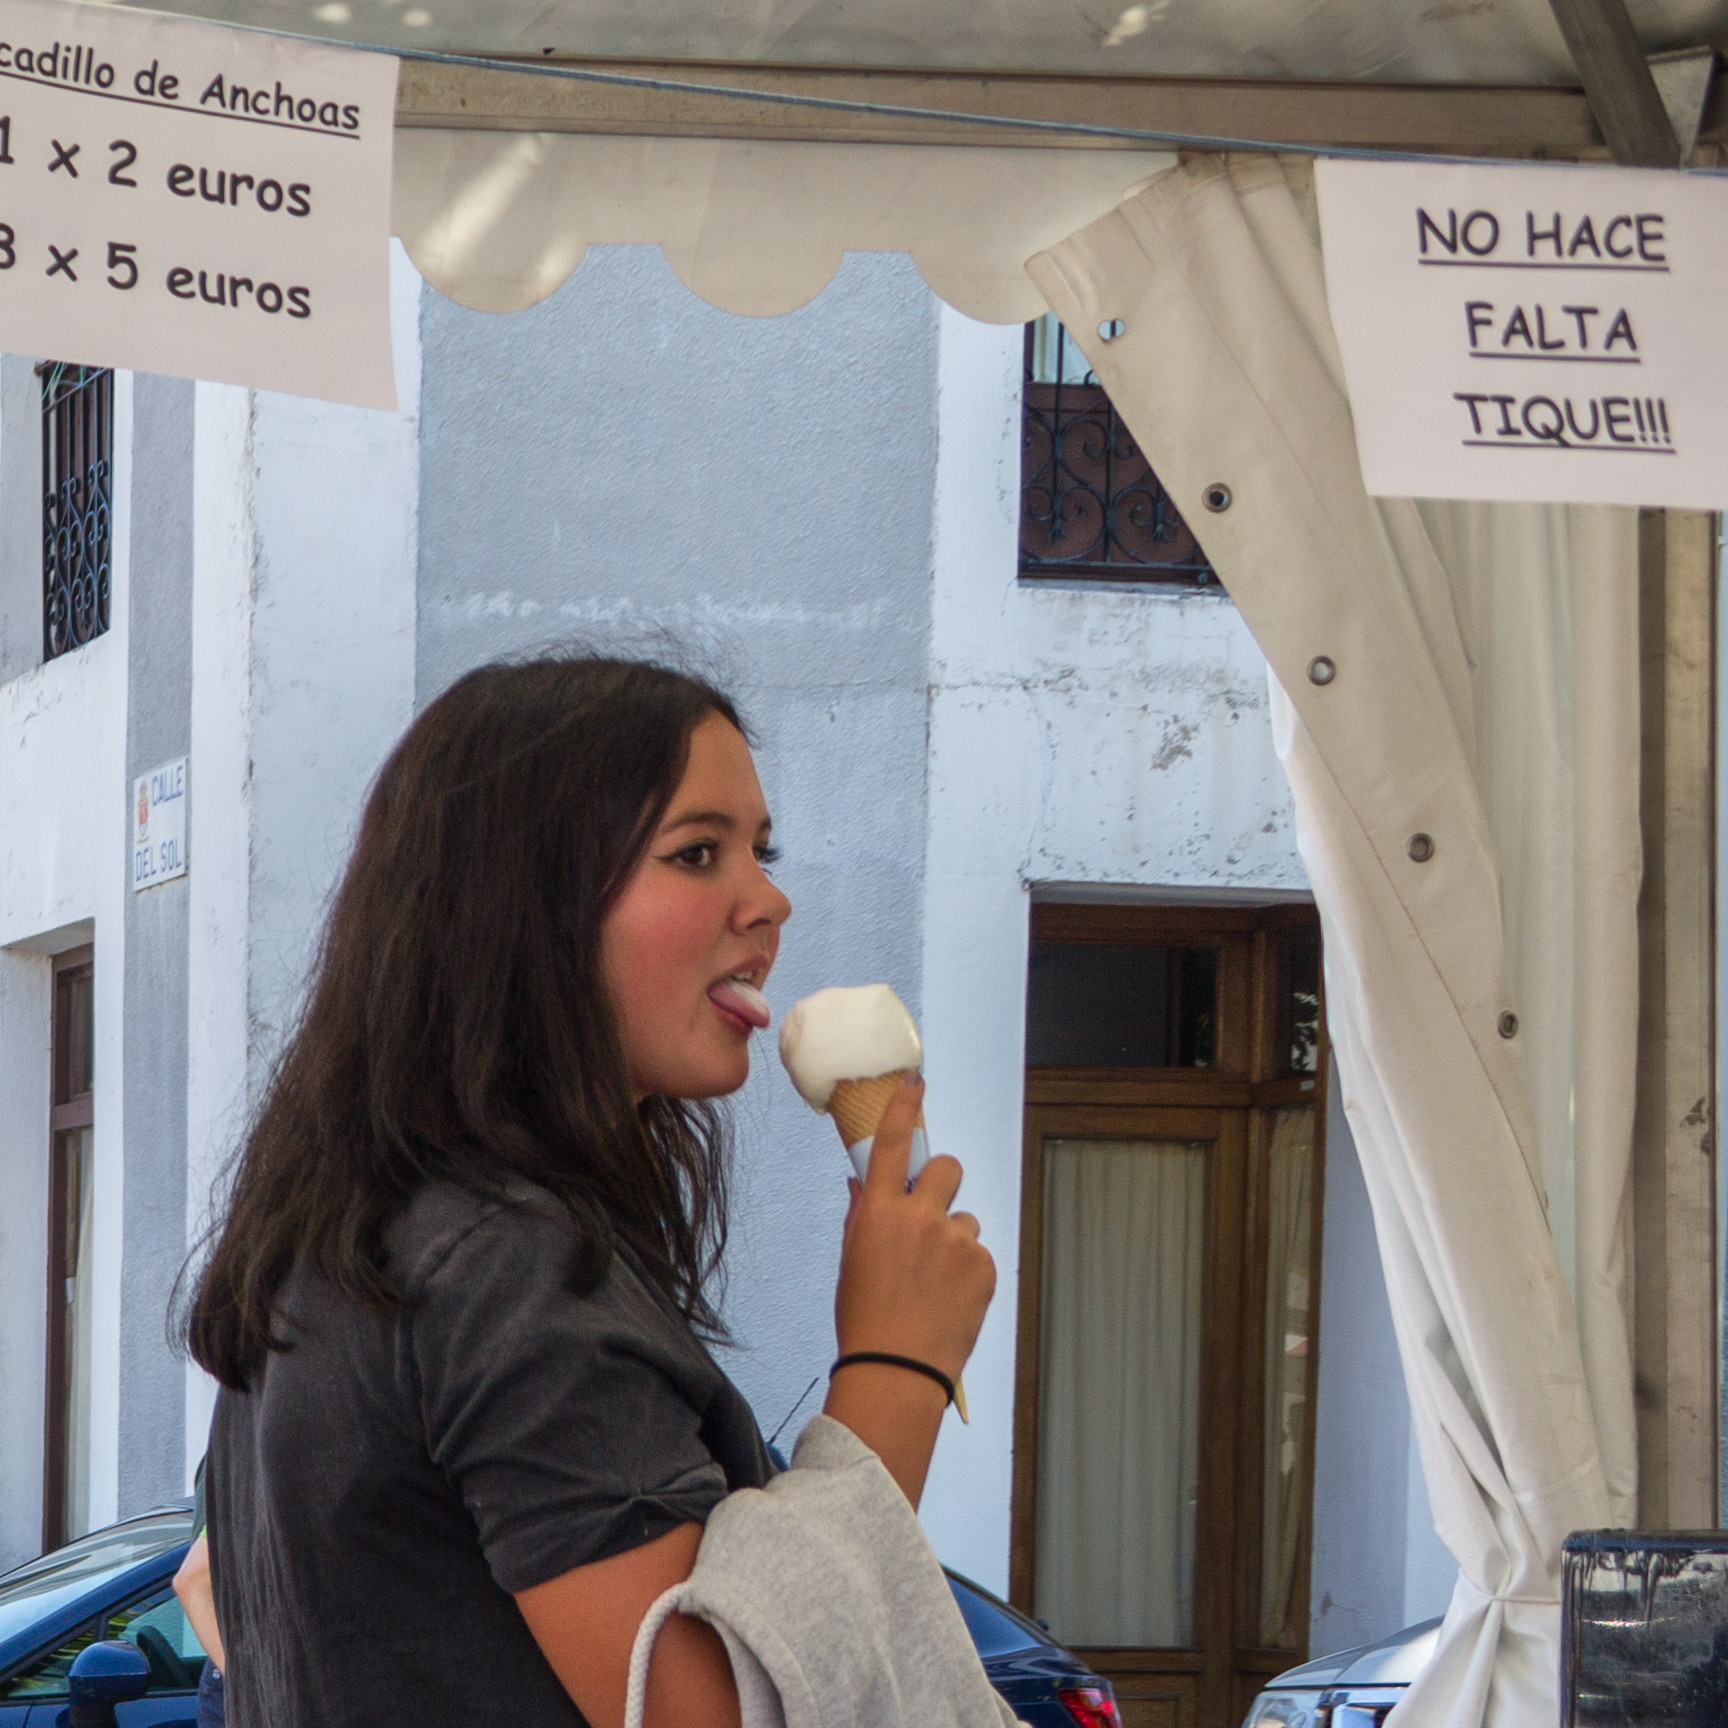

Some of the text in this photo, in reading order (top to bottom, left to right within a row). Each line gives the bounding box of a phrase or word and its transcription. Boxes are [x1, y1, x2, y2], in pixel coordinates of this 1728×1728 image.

[133, 60, 179, 100] de
[200, 73, 360, 130] Anchoas
[107, 139, 138, 187] 2
[166, 163, 311, 218] euros
[1416, 207, 1666, 262] NO HACE
[106, 241, 138, 290] 5
[166, 266, 311, 319] euros
[1465, 301, 1638, 351] FALTA
[1453, 392, 1672, 448] TIQUE!!!
[151, 764, 184, 807] CALLE
[136, 837, 182, 882] DEL SOL
